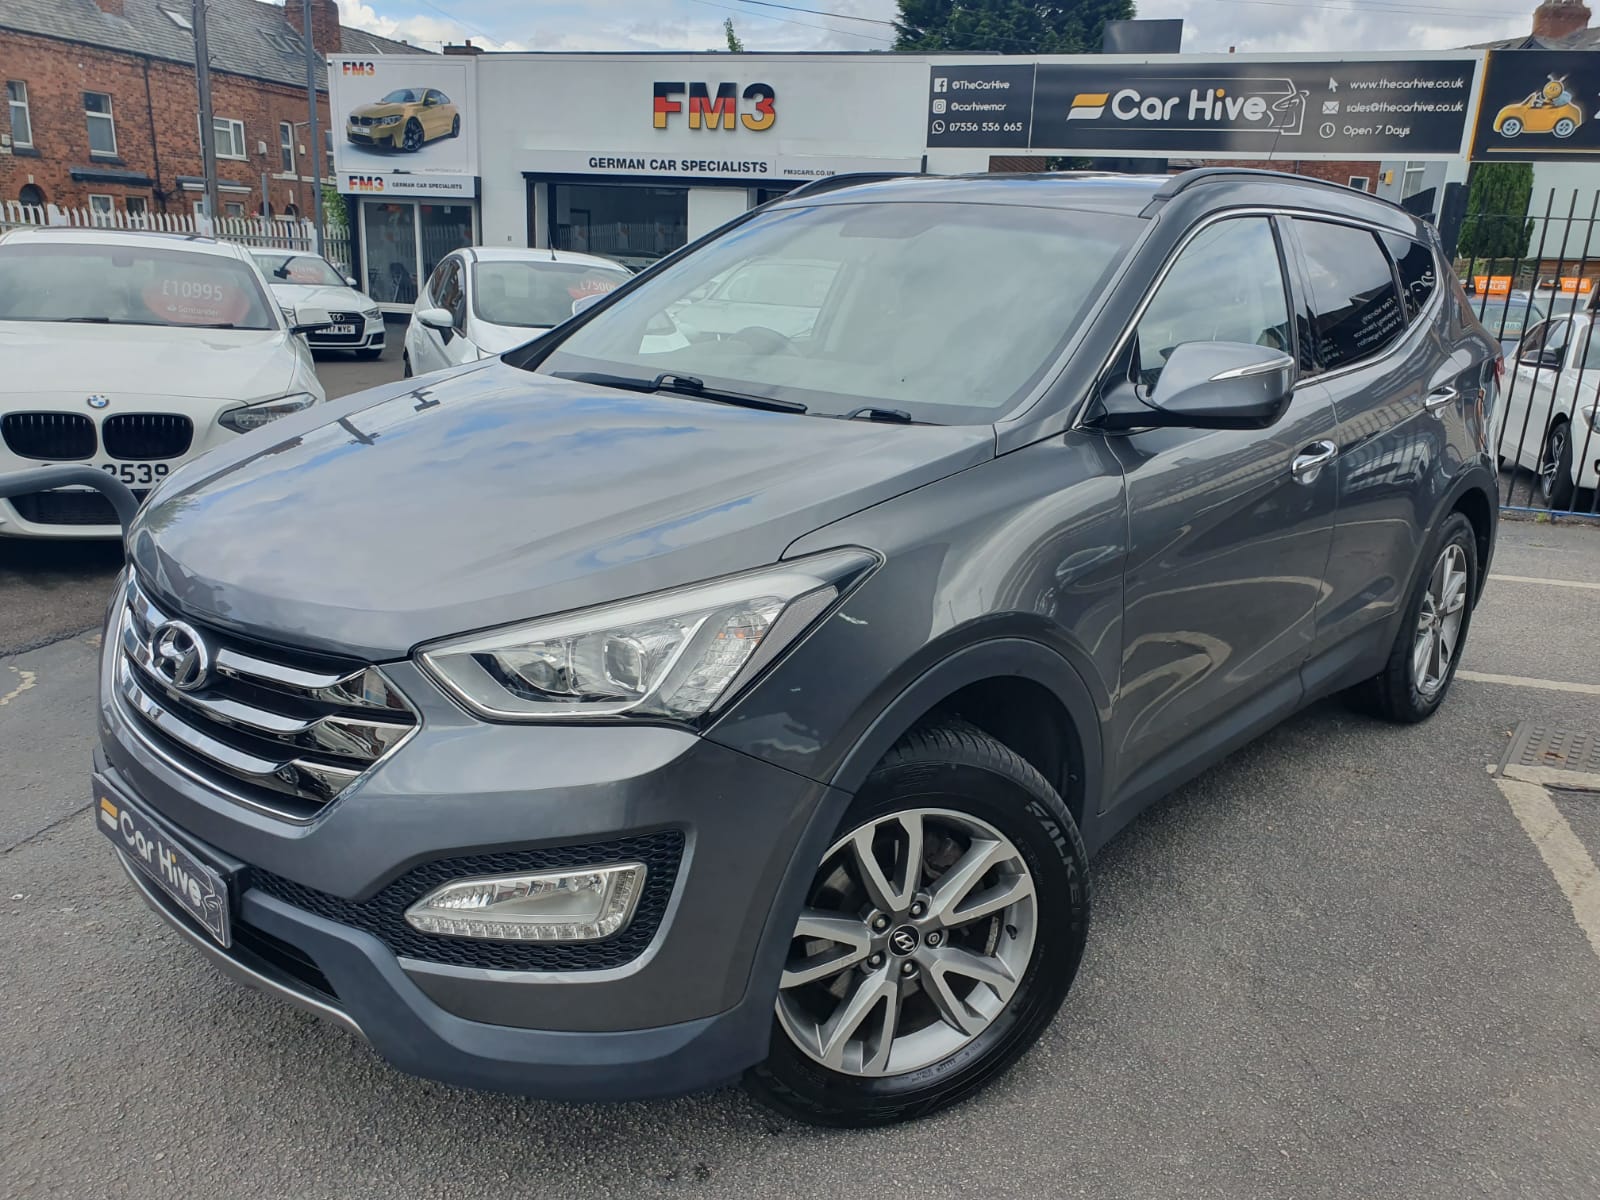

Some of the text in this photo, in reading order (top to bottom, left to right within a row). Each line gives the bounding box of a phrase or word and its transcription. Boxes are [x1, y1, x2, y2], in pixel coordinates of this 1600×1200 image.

[342, 61, 375, 76] FM3
[952, 80, 1010, 90] @TheCarHive
[1350, 78, 1464, 89] www.thecarhive.co.uk
[653, 82, 776, 131] FM3
[951, 101, 1006, 111] @carhivemcr
[1111, 88, 1267, 121] Car Hive
[1346, 102, 1464, 113] sales@thecarhive.co.uk
[949, 122, 1023, 132] 07556 556 665
[1343, 125, 1411, 137] Open 7 Days
[588, 157, 768, 174] GERMAN CAR SPECIALISTS
[348, 176, 385, 191] FM3
[162, 280, 224, 301] £10995
[120, 810, 202, 907] Car Hive
